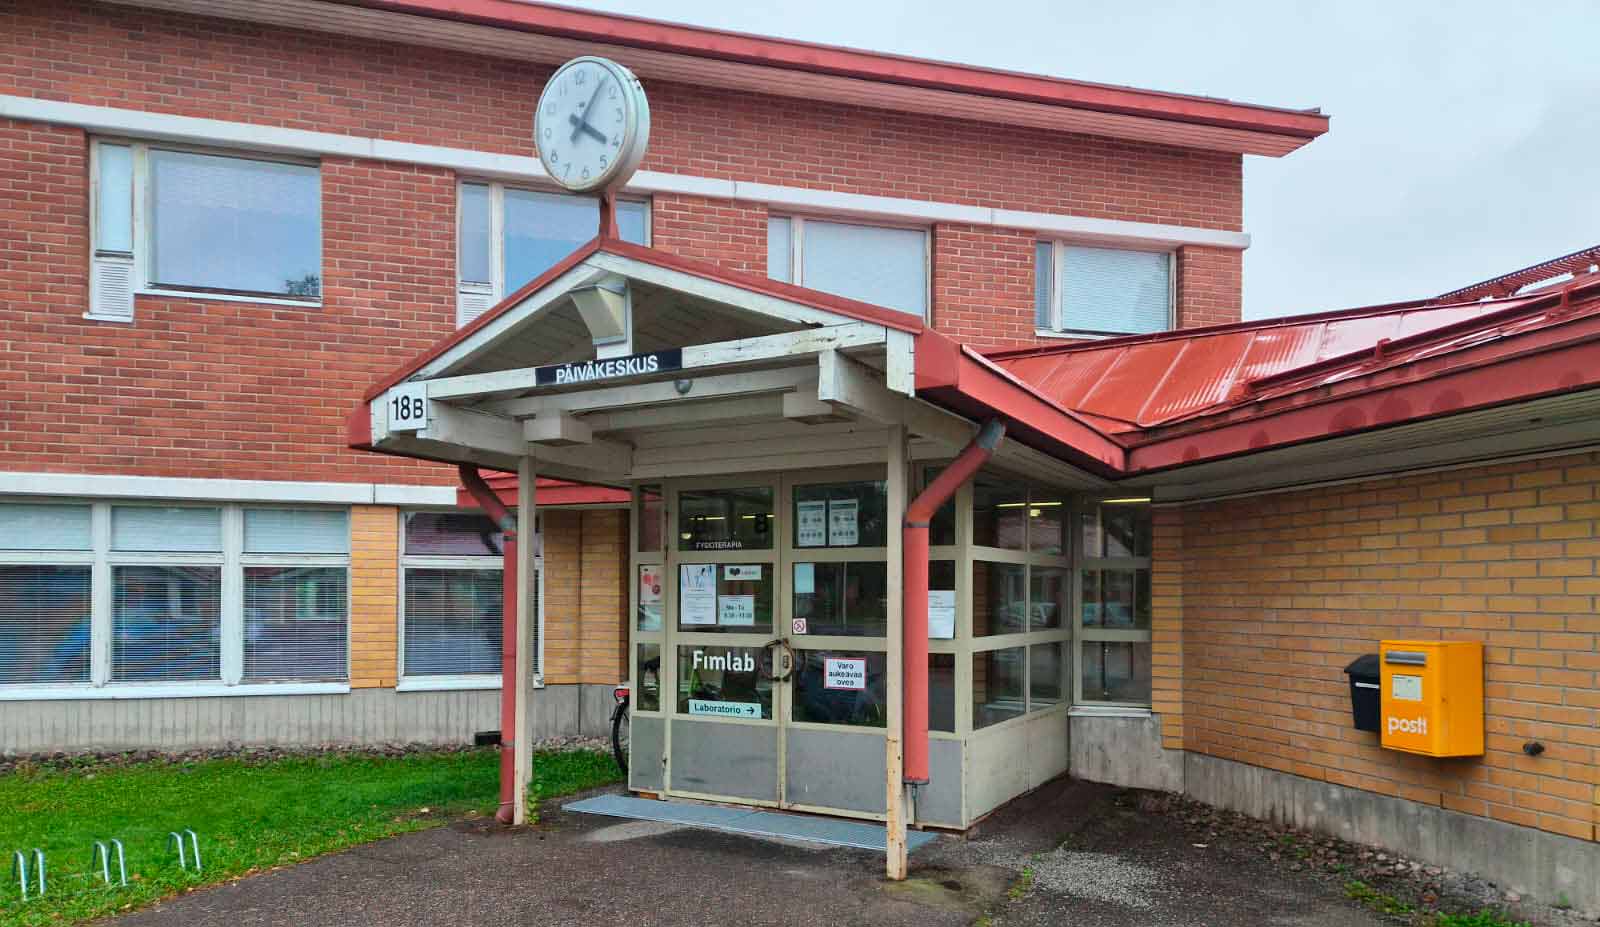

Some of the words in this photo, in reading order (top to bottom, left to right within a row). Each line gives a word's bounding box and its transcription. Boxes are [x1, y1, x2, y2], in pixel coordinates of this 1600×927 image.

[608, 87, 617, 99] 2
[616, 108, 624, 123] 3
[611, 134, 620, 147] 4
[550, 152, 559, 163] 8
[600, 155, 608, 170] 5
[563, 163, 571, 178] 7
[582, 167, 590, 180] 6
[556, 355, 658, 384] PÄIVÄKESKUS
[693, 650, 755, 672] Fimlab
[837, 662, 854, 670] Varo
[828, 670, 862, 679] aukeavaa
[836, 679, 854, 687] ovea
[694, 703, 741, 715] Laboratorio
[1387, 716, 1427, 736] posti
